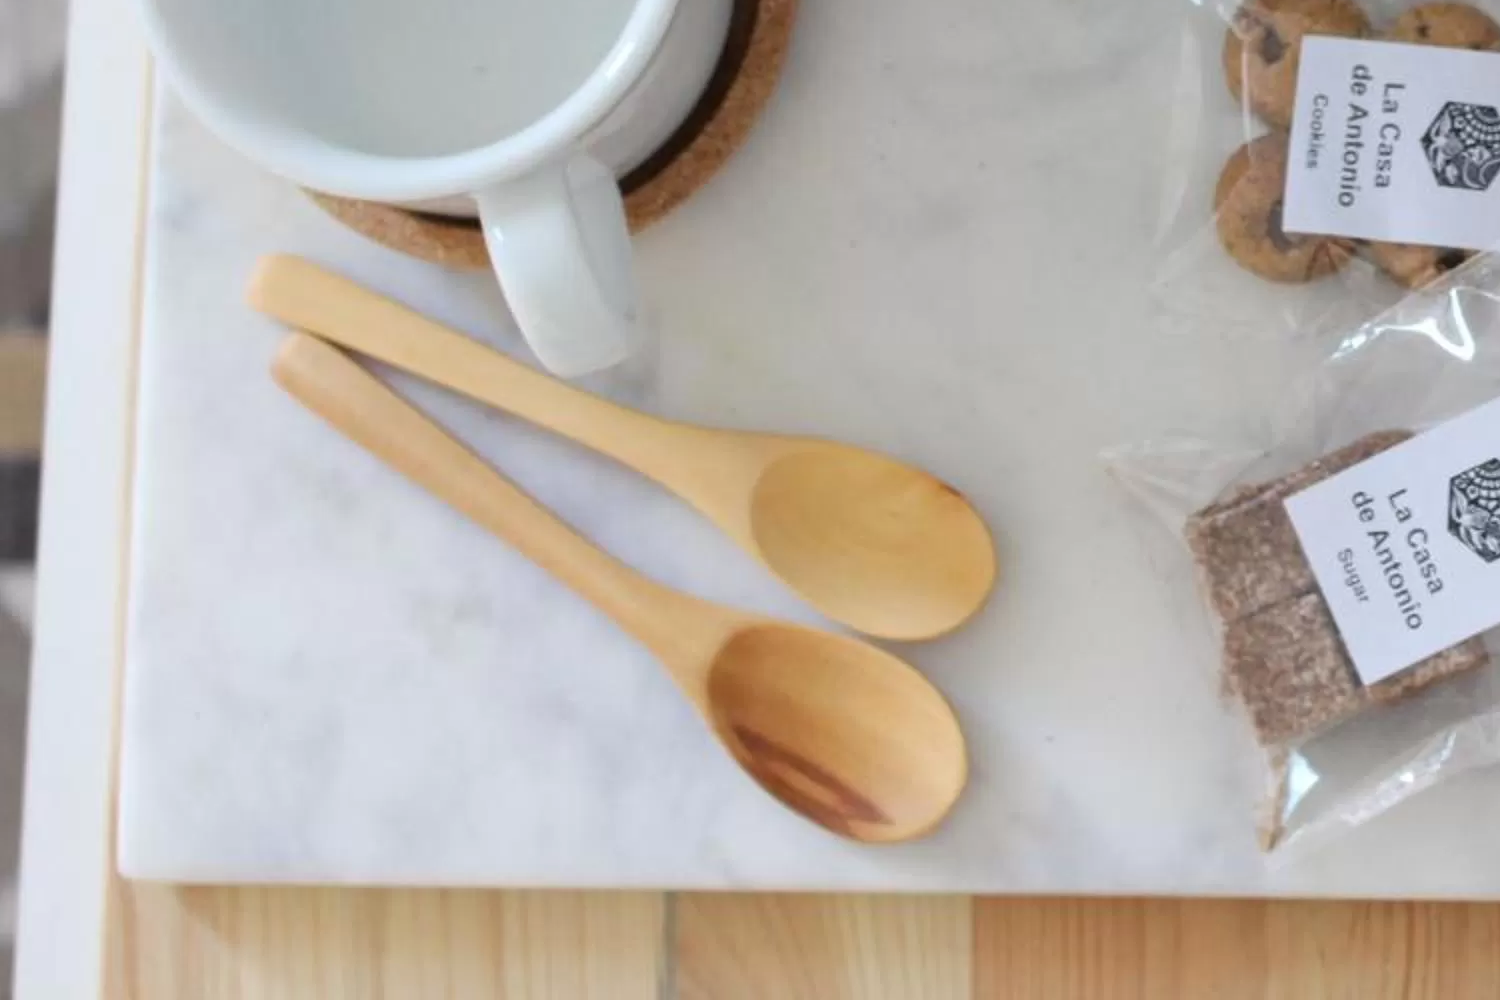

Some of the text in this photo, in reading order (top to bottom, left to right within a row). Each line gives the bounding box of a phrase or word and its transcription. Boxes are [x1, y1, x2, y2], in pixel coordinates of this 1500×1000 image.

[1306, 93, 1329, 169] Cookies
[1337, 63, 1373, 208] de Antonio
[1373, 82, 1406, 189] La Casa
[1337, 547, 1369, 603] Sugar
[1351, 490, 1423, 631] de Antonio
[1387, 487, 1444, 596] La Casa
